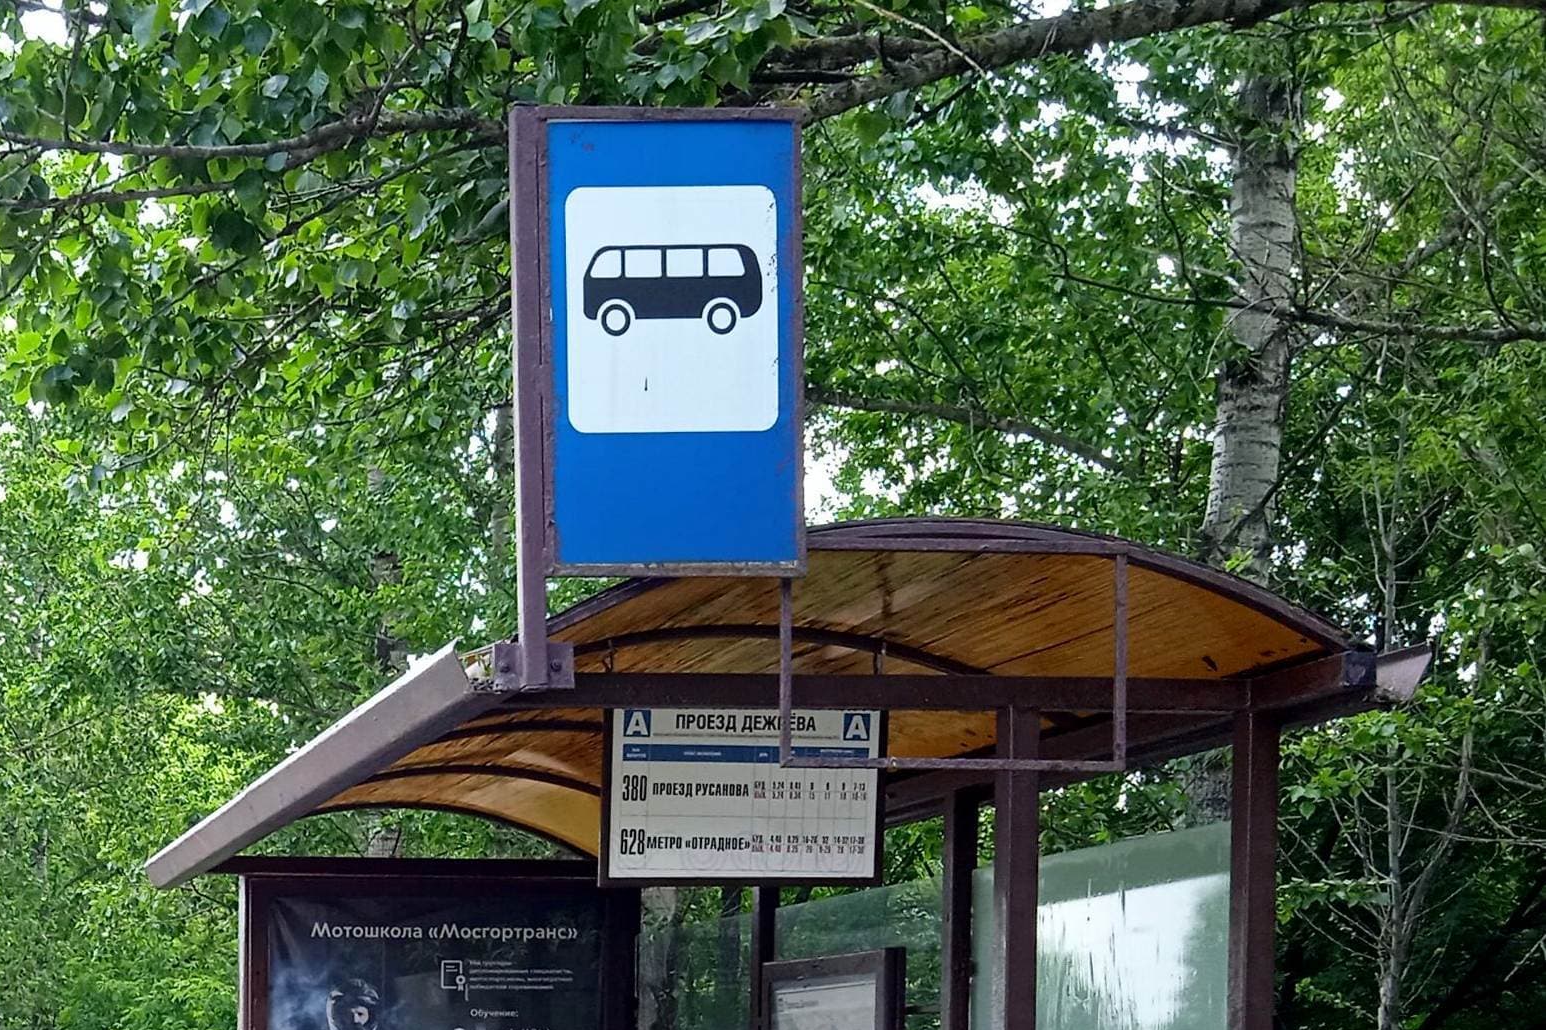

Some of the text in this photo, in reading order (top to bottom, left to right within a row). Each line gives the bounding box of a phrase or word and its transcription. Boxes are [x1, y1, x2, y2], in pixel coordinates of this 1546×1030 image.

[675, 714, 737, 732] ПРОЕЗД
[622, 775, 749, 801] 380 ПРОЕЗД РУСАНОВА
[620, 829, 751, 855] 628 МЕТРО «ОТРАДНОЕ»
[311, 922, 578, 942] Мотошкола «Мосгортранс»
[470, 1008, 519, 1018] Обучение:
